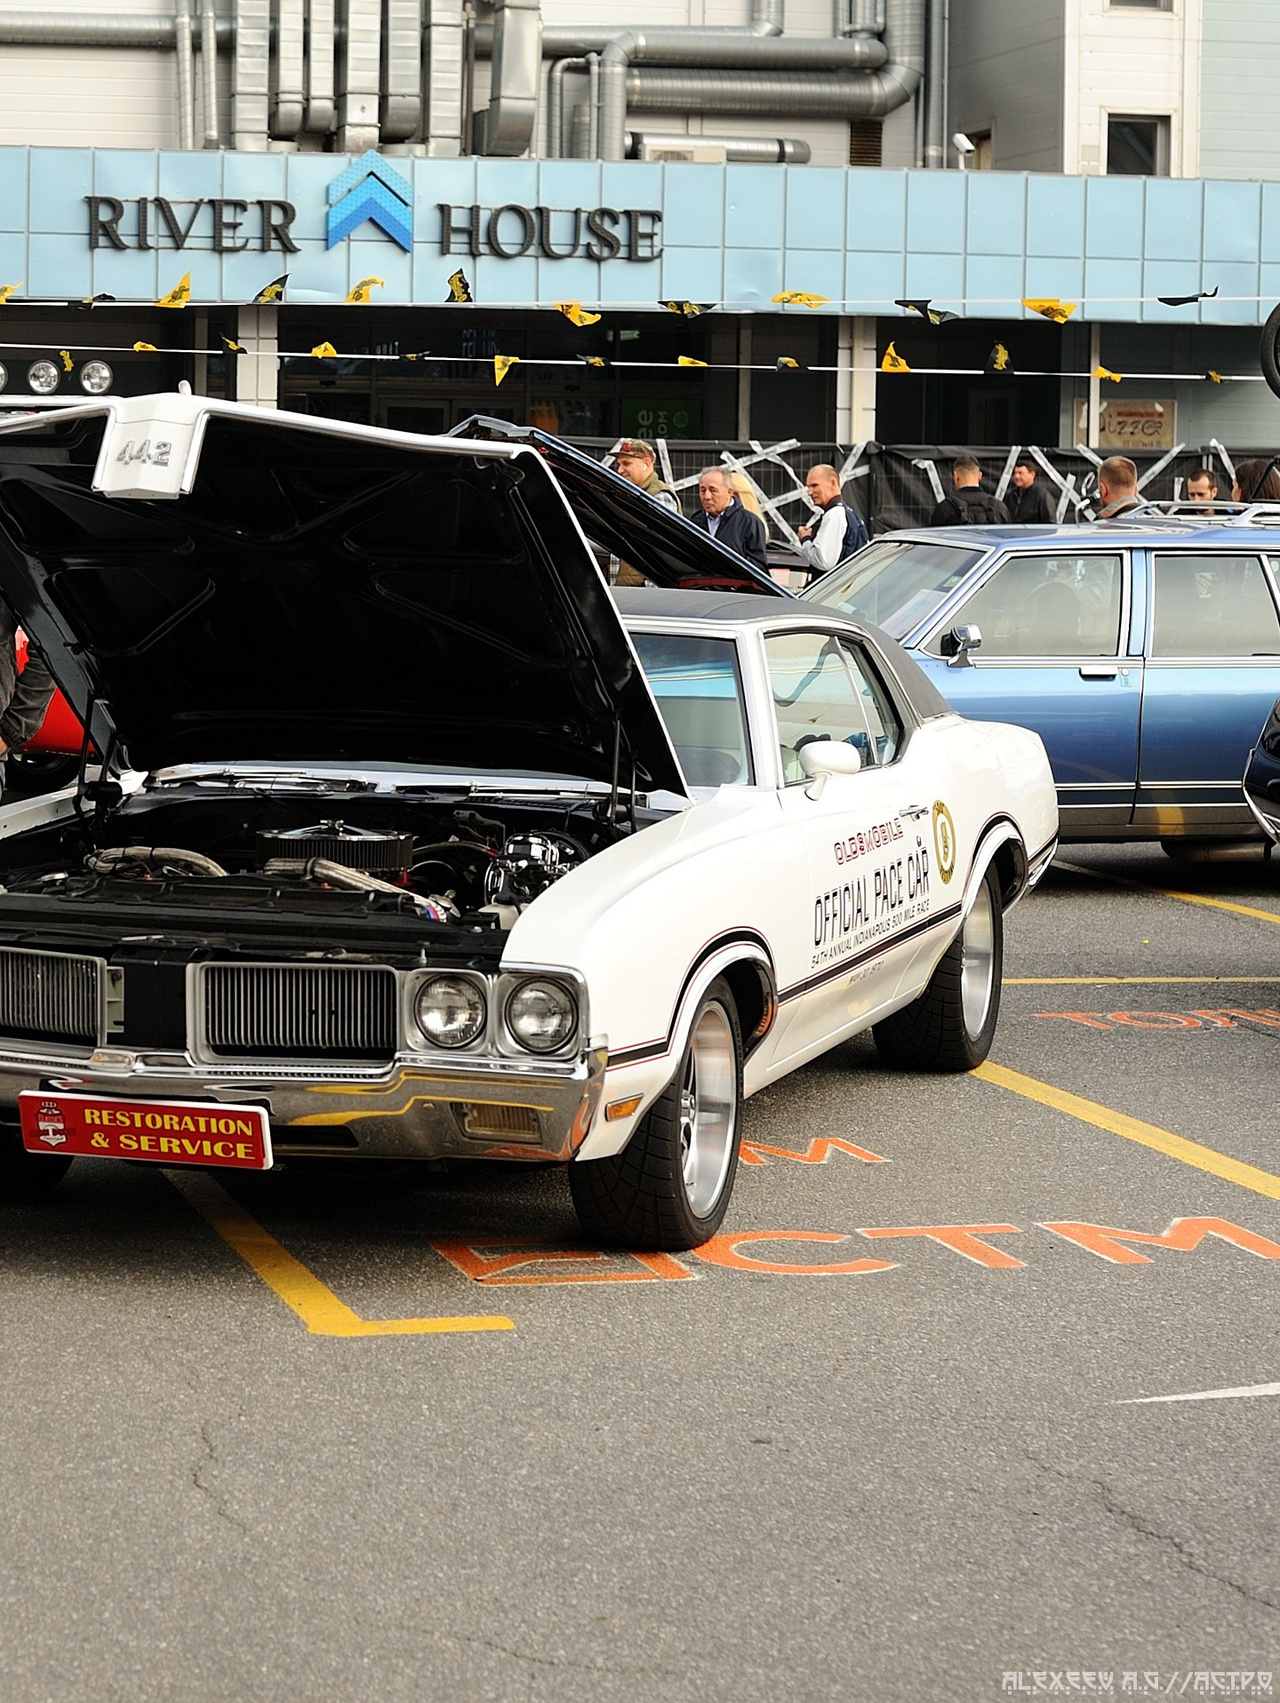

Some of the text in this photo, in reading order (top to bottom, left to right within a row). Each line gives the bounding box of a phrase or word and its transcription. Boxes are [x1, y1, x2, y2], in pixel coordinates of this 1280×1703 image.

[86, 195, 664, 262] RIVER HOUSE
[117, 439, 173, 467] 442
[834, 818, 904, 865] OLDSMOBILE
[814, 847, 929, 949] OFFICIAL PACE CAR
[829, 937, 852, 959] ANNUAL
[853, 918, 891, 945] INDIANAPOLIS
[904, 904, 915, 922] MILE
[917, 898, 930, 916] RACE
[84, 1108, 253, 1137] RESTORATION
[90, 1131, 256, 1161] & SERVICE
